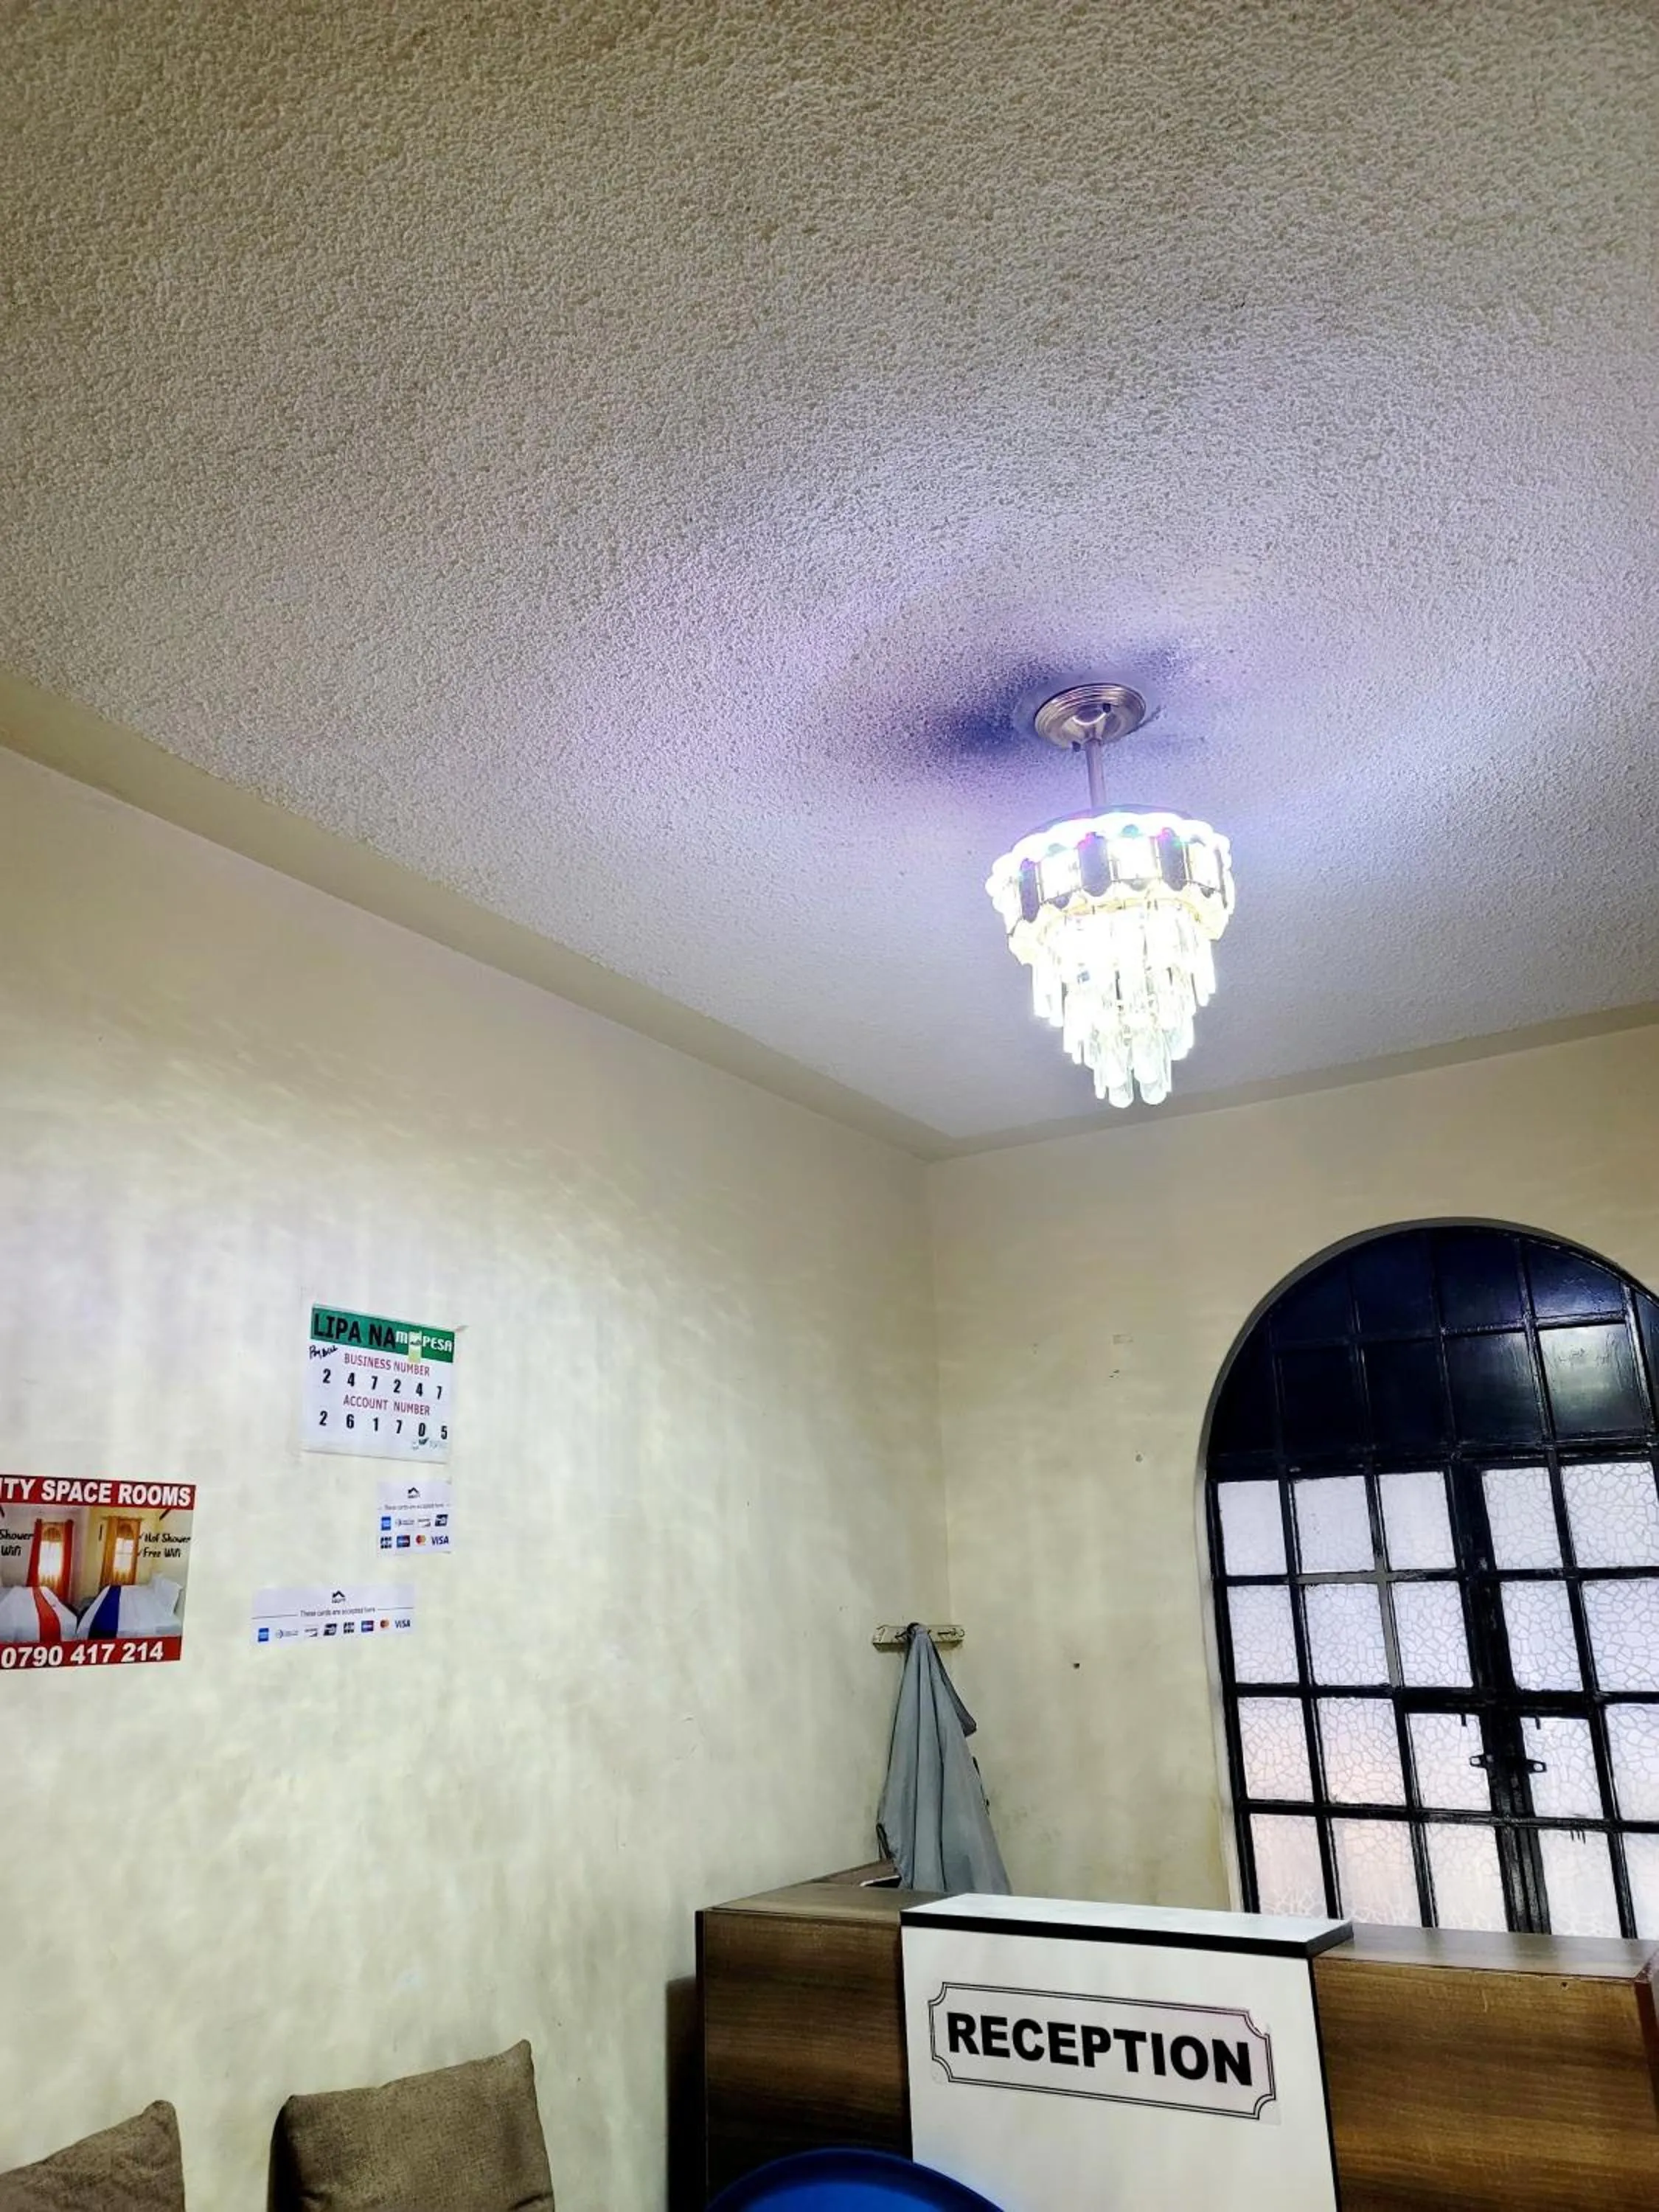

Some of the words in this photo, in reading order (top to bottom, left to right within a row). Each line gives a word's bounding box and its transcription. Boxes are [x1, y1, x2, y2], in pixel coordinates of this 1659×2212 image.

[313, 1313, 361, 1343] LIPA
[368, 1324, 396, 1349] NA
[344, 1352, 392, 1371] BUSINESS
[393, 1361, 431, 1377] NUMBER
[322, 1368, 332, 1384] 2
[347, 1372, 355, 1387] 4
[371, 1376, 378, 1390] 7
[393, 1379, 402, 1394] 2
[415, 1382, 423, 1397] 4
[437, 1385, 443, 1399] 7
[343, 1394, 389, 1411] ACCOUNT
[393, 1400, 431, 1416] NUMBER
[319, 1411, 328, 1426] 2
[346, 1413, 355, 1429] 6
[372, 1417, 379, 1432] 1
[396, 1419, 403, 1434] 7
[418, 1422, 426, 1437] 0
[440, 1425, 448, 1440] 5
[41, 1479, 111, 1504] SPACE
[117, 1484, 192, 1506] ROOMS
[143, 1547, 161, 1557] Free
[431, 1536, 449, 1545] VISA
[394, 1619, 411, 1629] VISA
[1, 1646, 63, 1669] 0790
[71, 1644, 115, 1664] 417
[121, 1641, 164, 1663] 214
[947, 2011, 1253, 2087] RECEPTION
